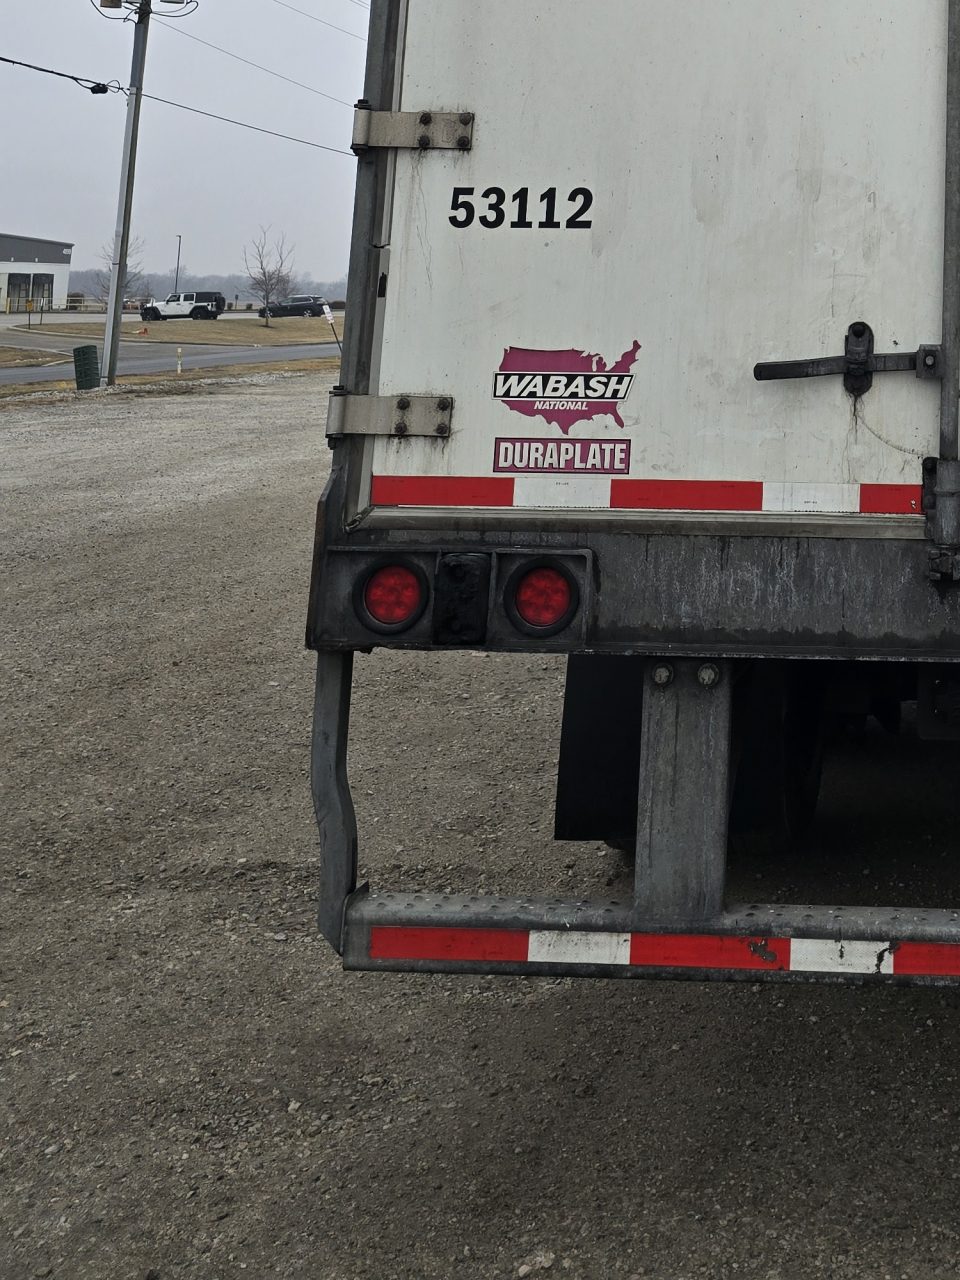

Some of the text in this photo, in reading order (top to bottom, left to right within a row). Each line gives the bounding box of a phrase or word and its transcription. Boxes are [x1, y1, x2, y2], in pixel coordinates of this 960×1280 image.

[448, 186, 594, 229] 53112
[495, 375, 632, 398] WABASH
[533, 400, 589, 411] NATIONAL
[498, 441, 628, 469] DURAPLATE
